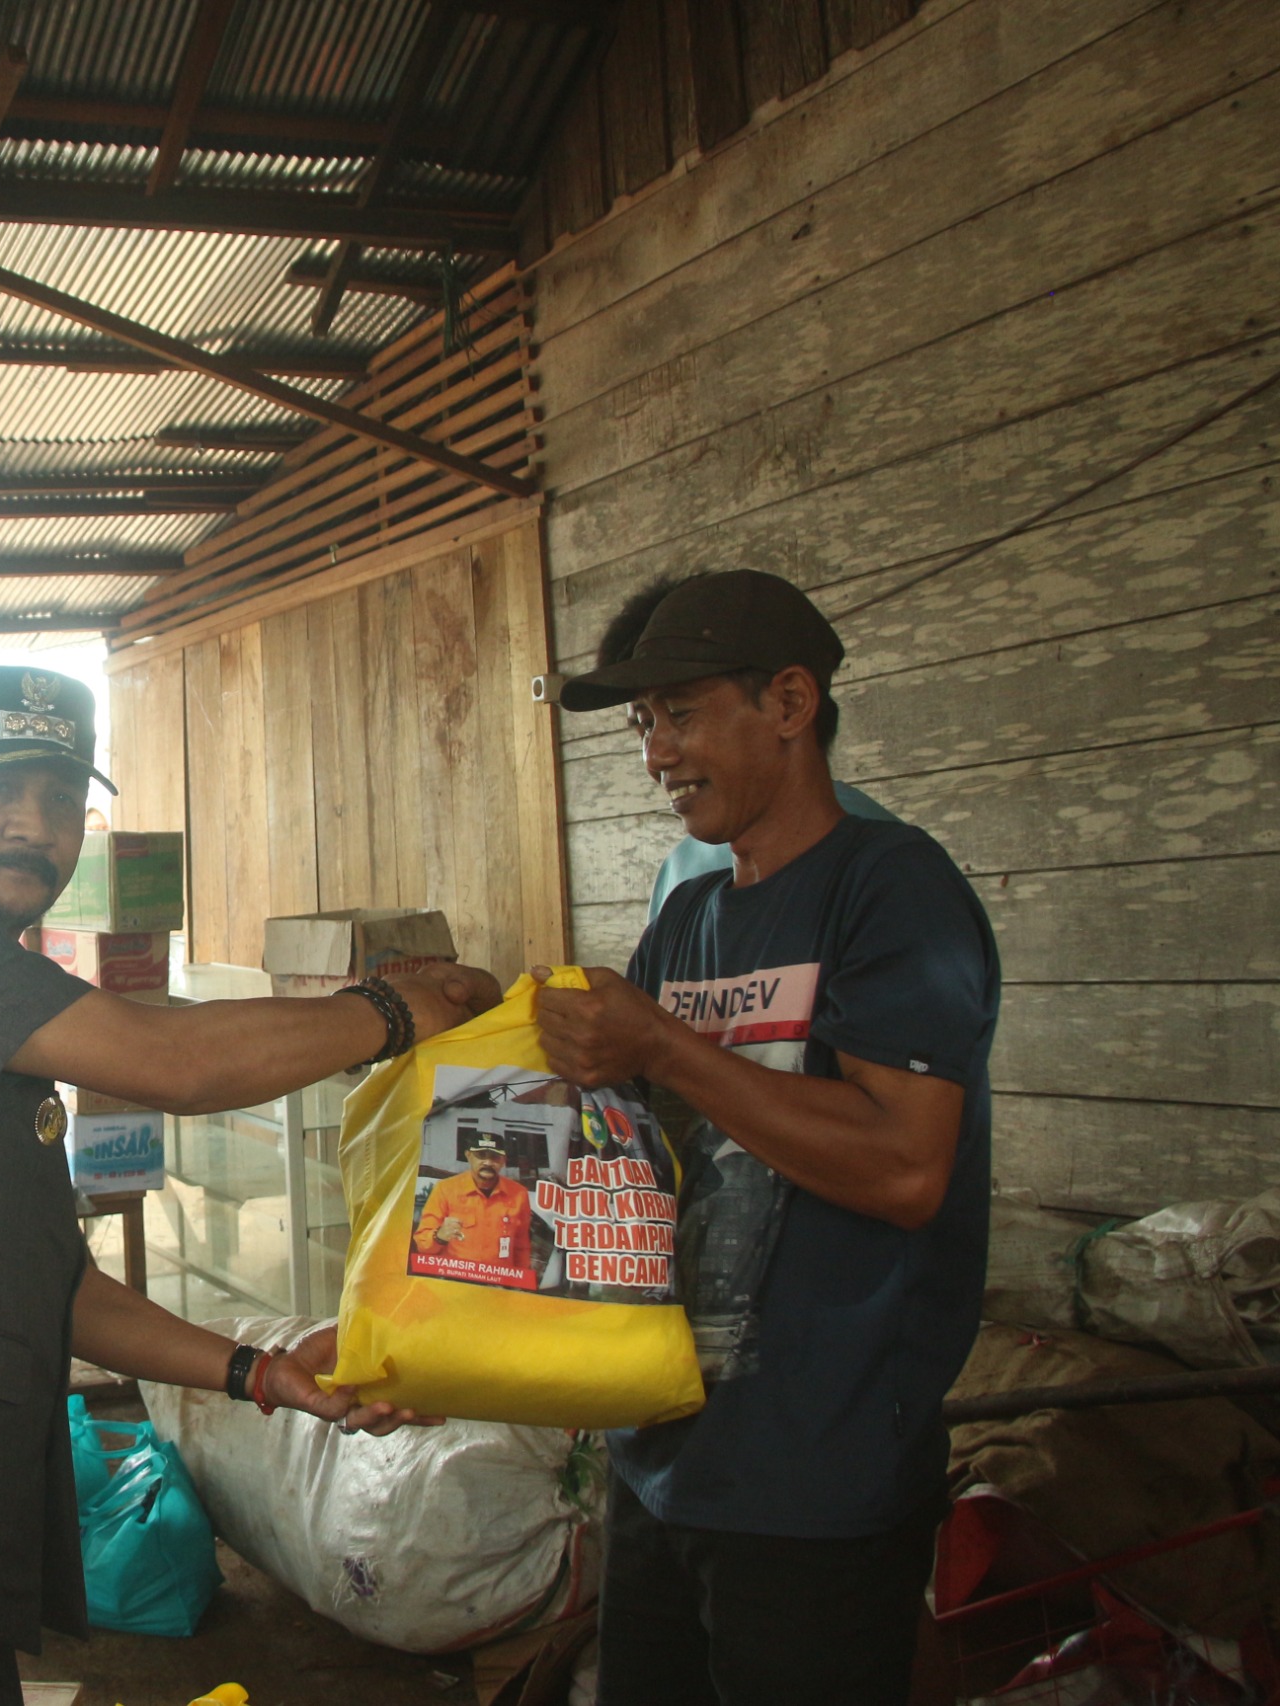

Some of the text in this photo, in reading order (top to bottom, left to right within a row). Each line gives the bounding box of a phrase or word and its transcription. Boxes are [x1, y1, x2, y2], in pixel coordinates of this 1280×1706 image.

[567, 1155, 657, 1190] BANTUAN
[536, 1180, 677, 1223] UNTUK KORBAN
[553, 1218, 674, 1255] TERDAMPAK
[478, 1263, 524, 1279] RAHMAN
[566, 1252, 668, 1287] BENCANA
